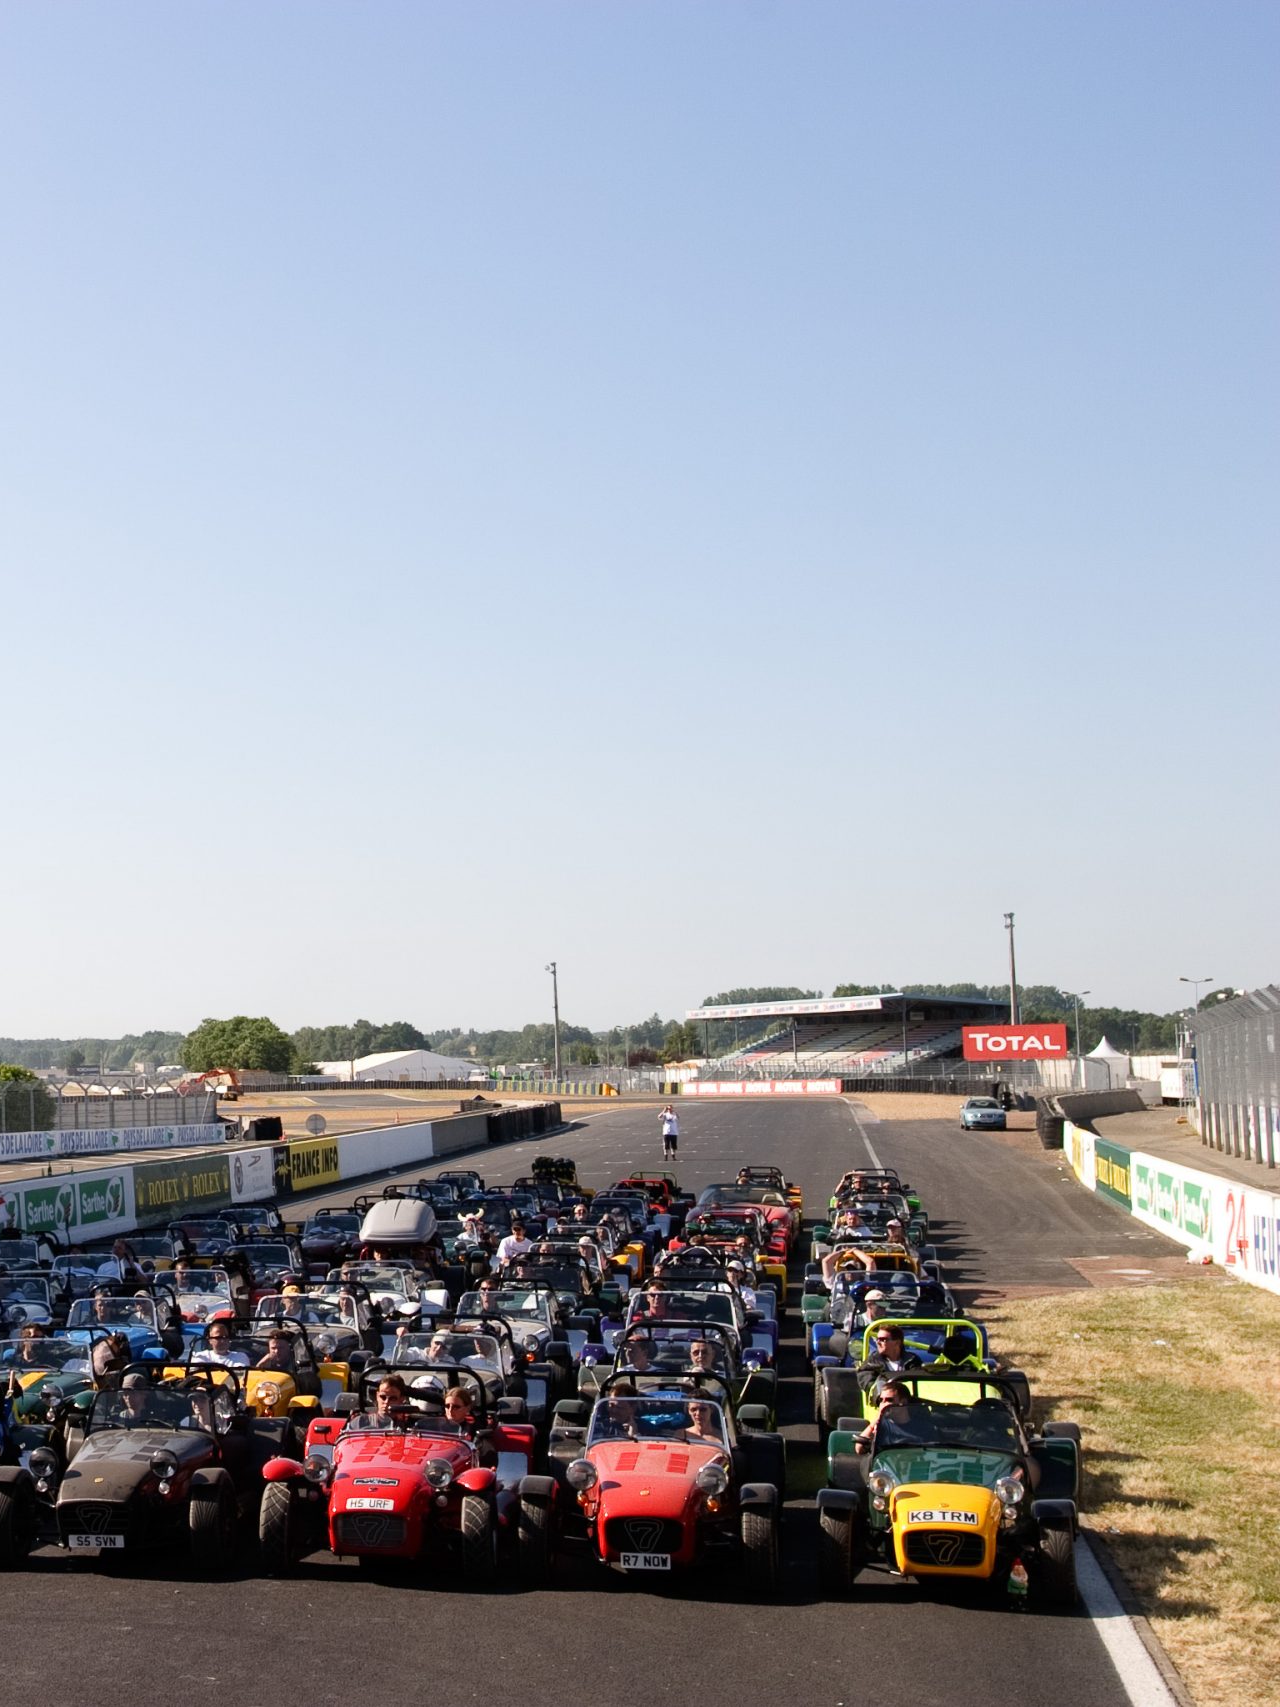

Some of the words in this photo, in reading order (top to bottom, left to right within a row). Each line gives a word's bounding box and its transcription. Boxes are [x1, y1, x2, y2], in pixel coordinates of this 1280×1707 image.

[968, 1033, 1061, 1052] TOTAL
[291, 1151, 320, 1180] FRANCE
[322, 1146, 339, 1172] INFO
[148, 1179, 180, 1206] ROLEX
[192, 1171, 220, 1197] ROLEX
[28, 1201, 55, 1226] Sarthe
[82, 1193, 106, 1215] Sarthe
[1225, 1192, 1249, 1270] 24
[369, 1499, 390, 1509] URF
[911, 1511, 933, 1521] K8
[938, 1511, 976, 1523] TRM
[76, 1536, 91, 1547] S5
[95, 1536, 117, 1547] SVN
[623, 1554, 639, 1567] R7
[643, 1555, 669, 1568] NOW
